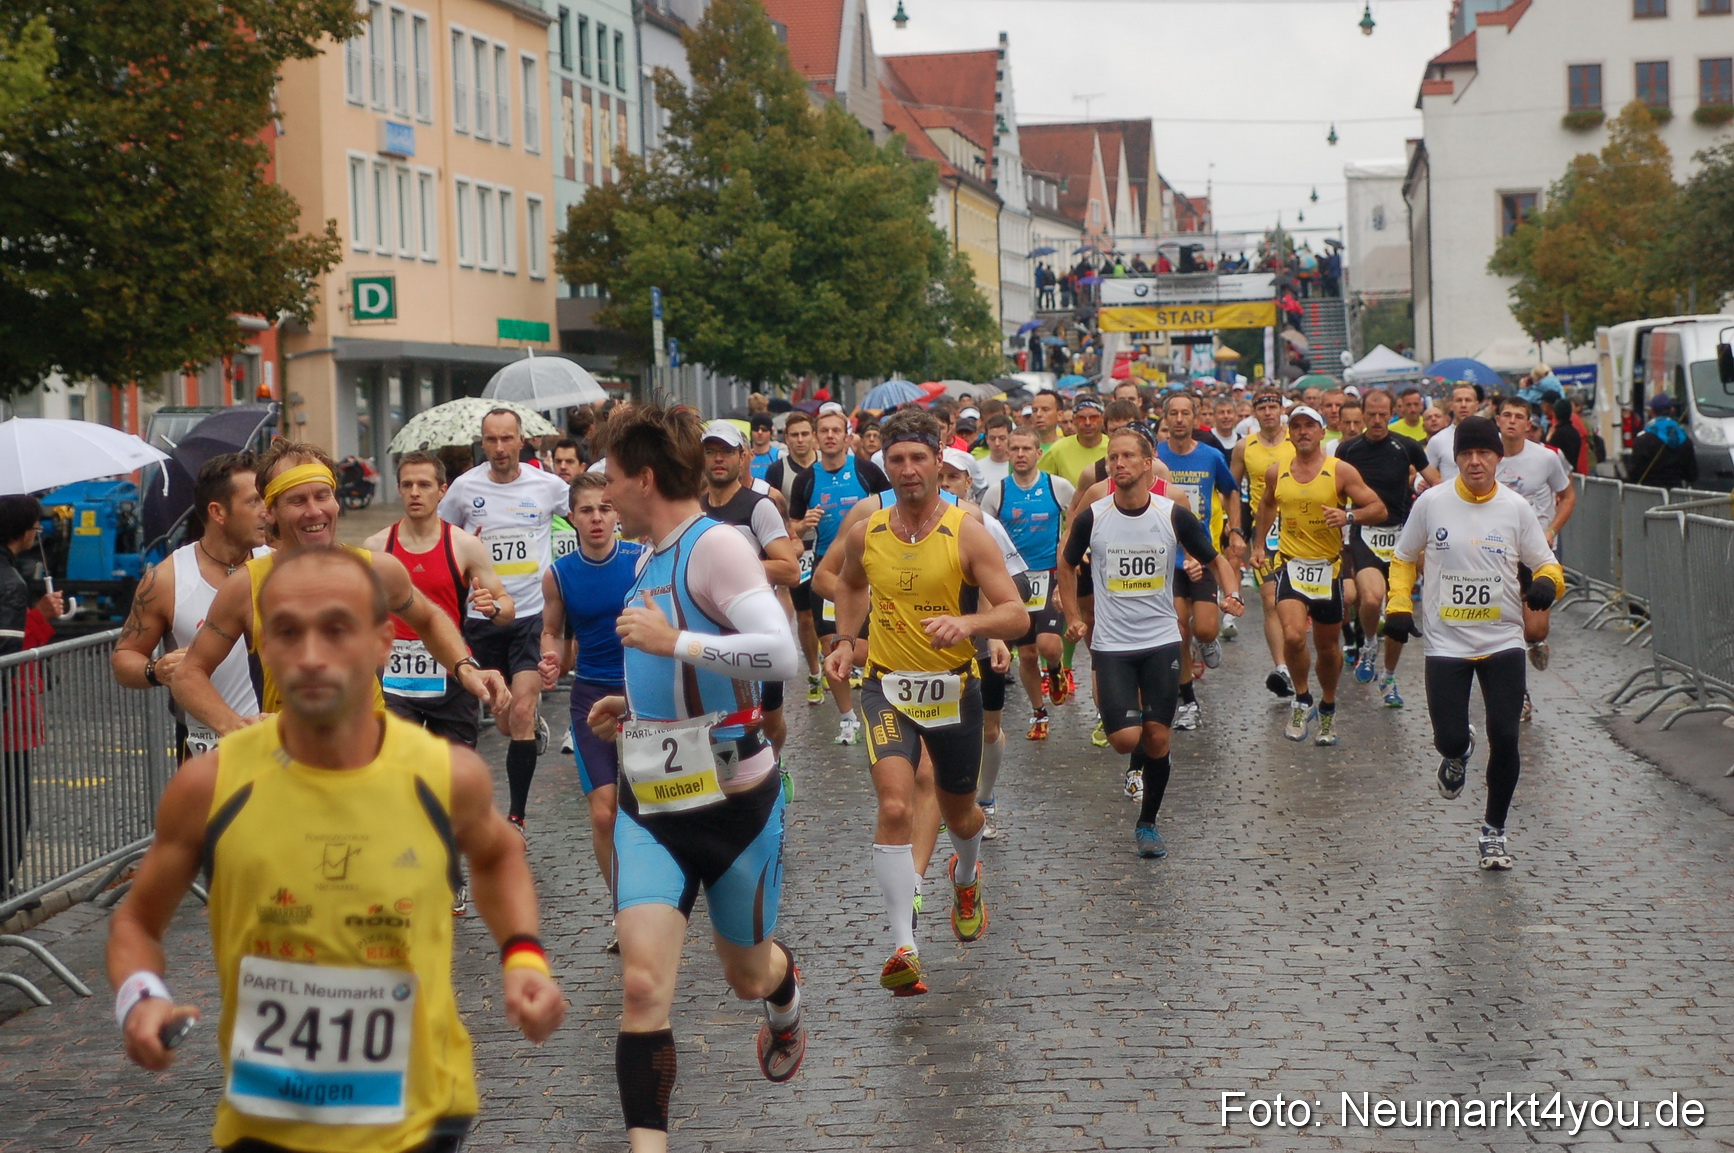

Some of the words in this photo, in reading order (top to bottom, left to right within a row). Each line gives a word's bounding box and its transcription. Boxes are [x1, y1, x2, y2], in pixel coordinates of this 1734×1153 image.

[358, 283, 389, 314] D
[1156, 309, 1216, 326] START
[1370, 533, 1396, 547] 400
[492, 540, 527, 562] 578
[1119, 556, 1156, 577] 506
[1296, 566, 1324, 583] 367
[1122, 580, 1152, 590] Hannes
[1441, 574, 1461, 582] PARTL
[1452, 584, 1491, 605] 526
[914, 600, 950, 612] RÖDL
[1444, 607, 1491, 620] LOTHAR
[390, 653, 438, 675] 3161
[898, 678, 945, 703] 370
[625, 728, 653, 740] PARTL
[882, 712, 900, 738] Run!
[190, 732, 213, 740] PARTL
[661, 737, 683, 774] 2
[653, 777, 704, 800] Michael
[243, 973, 299, 996] PARTL
[303, 981, 385, 1000] Neumarkt
[252, 998, 396, 1064] 2410
[278, 1075, 355, 1106] Jürgen
